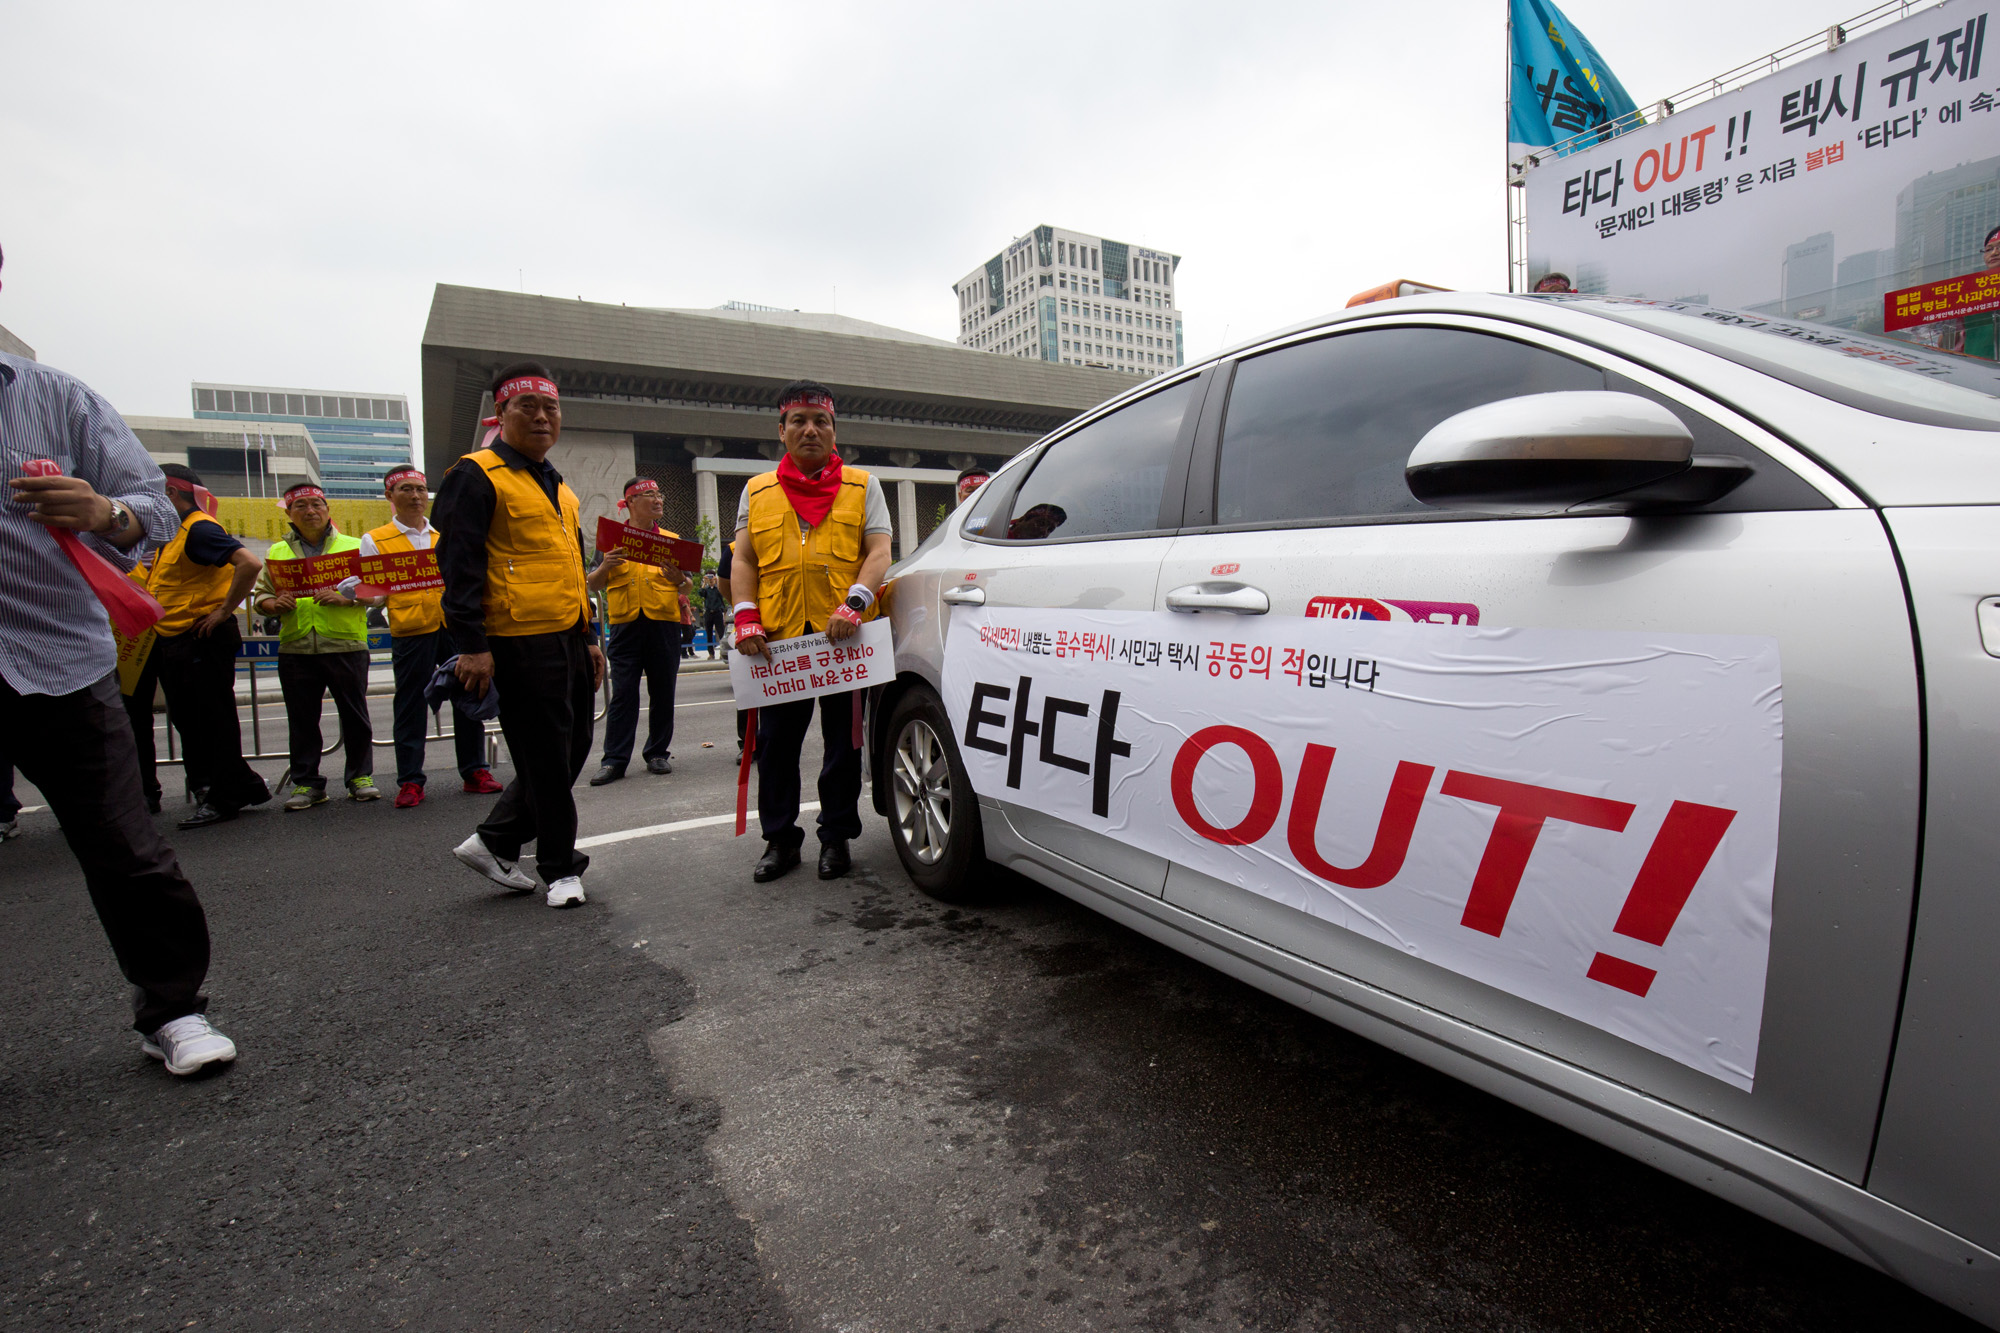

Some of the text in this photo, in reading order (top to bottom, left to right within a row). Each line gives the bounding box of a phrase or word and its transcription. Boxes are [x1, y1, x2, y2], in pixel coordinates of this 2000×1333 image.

[1562, 159, 1624, 217] 타다
[1633, 125, 1716, 193] OUT
[1780, 61, 1867, 137] 택시
[1880, 13, 1989, 109] 규제
[1735, 172, 1753, 194] 은
[1759, 158, 1797, 185] 지금
[1805, 140, 1845, 172] 불법
[1938, 99, 1962, 124] 에
[1896, 290, 1921, 306] 불법
[1896, 298, 1951, 317] 대통령님,
[500, 380, 557, 397] 정치적 결단
[302, 568, 351, 586] 사과하세요
[360, 560, 384, 573] 불법
[363, 570, 413, 585] 대통령님,
[815, 643, 874, 668] 이재웅은
[980, 626, 1380, 692] 미세먼지 내뿜는 꼼수택시! 시민과 택시 공동의 적입니다
[762, 663, 869, 697] 공유경제 마피아
[964, 676, 1738, 999] 타다 OUT!
